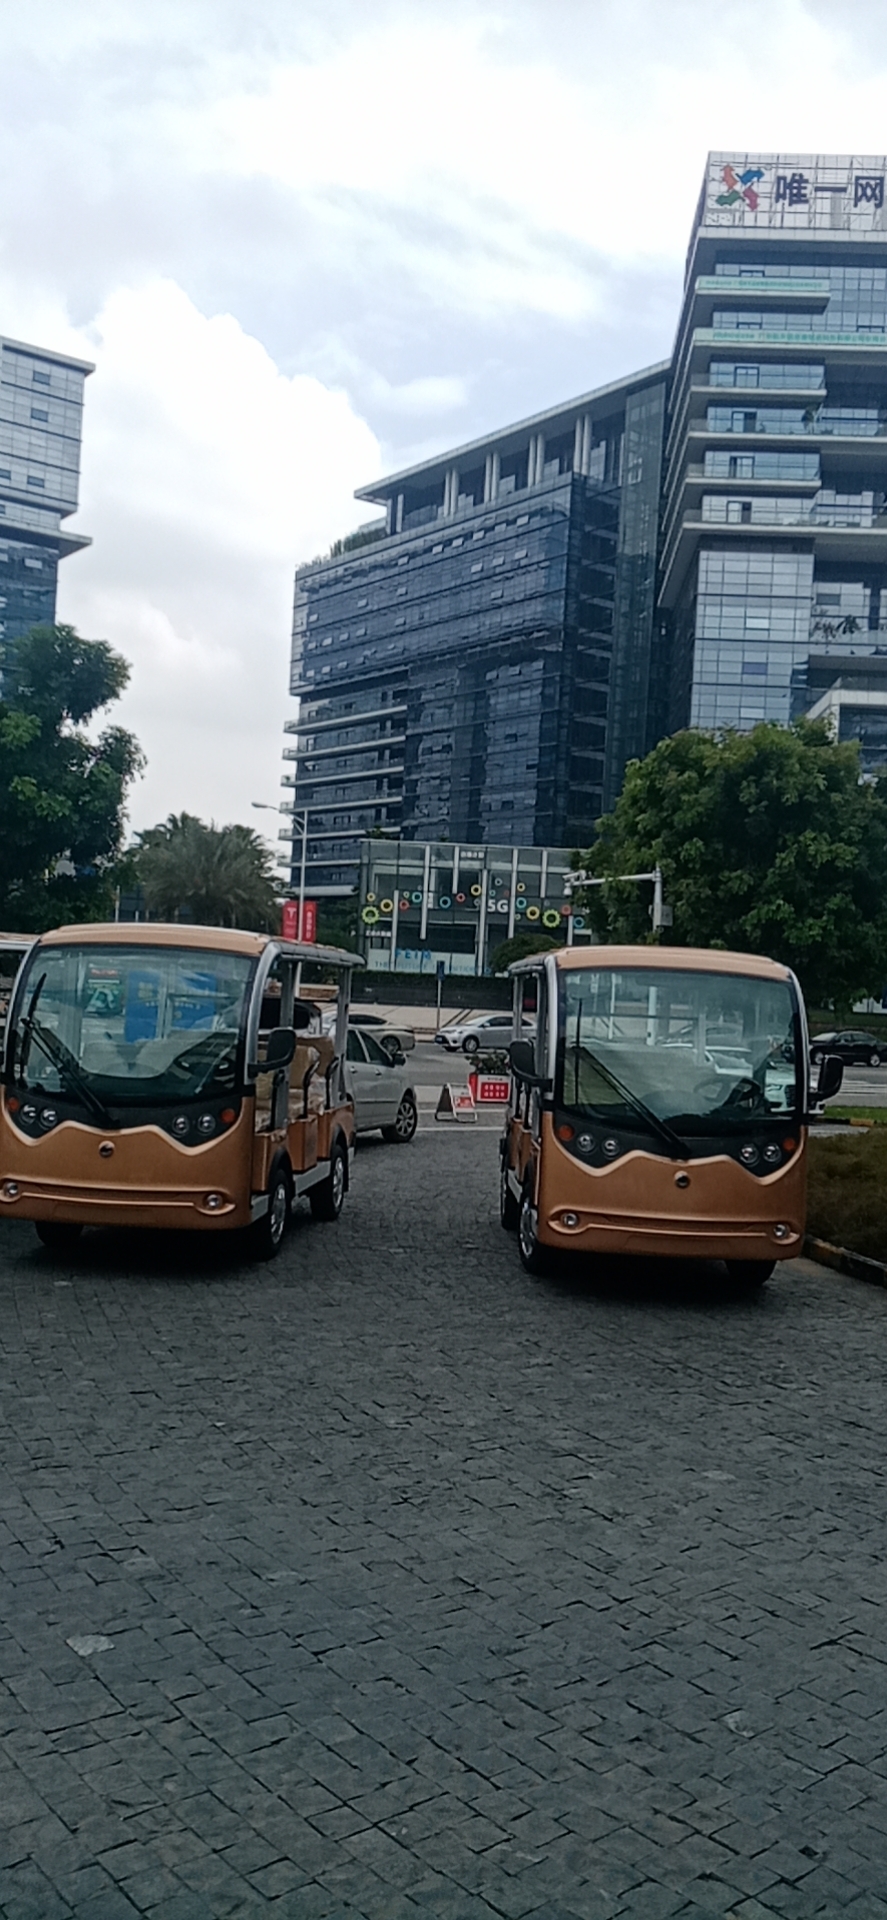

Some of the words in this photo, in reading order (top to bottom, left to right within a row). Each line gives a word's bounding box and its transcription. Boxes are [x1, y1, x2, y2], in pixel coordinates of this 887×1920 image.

[775, 173, 884, 208] 唯一网
[487, 899, 508, 913] 5G
